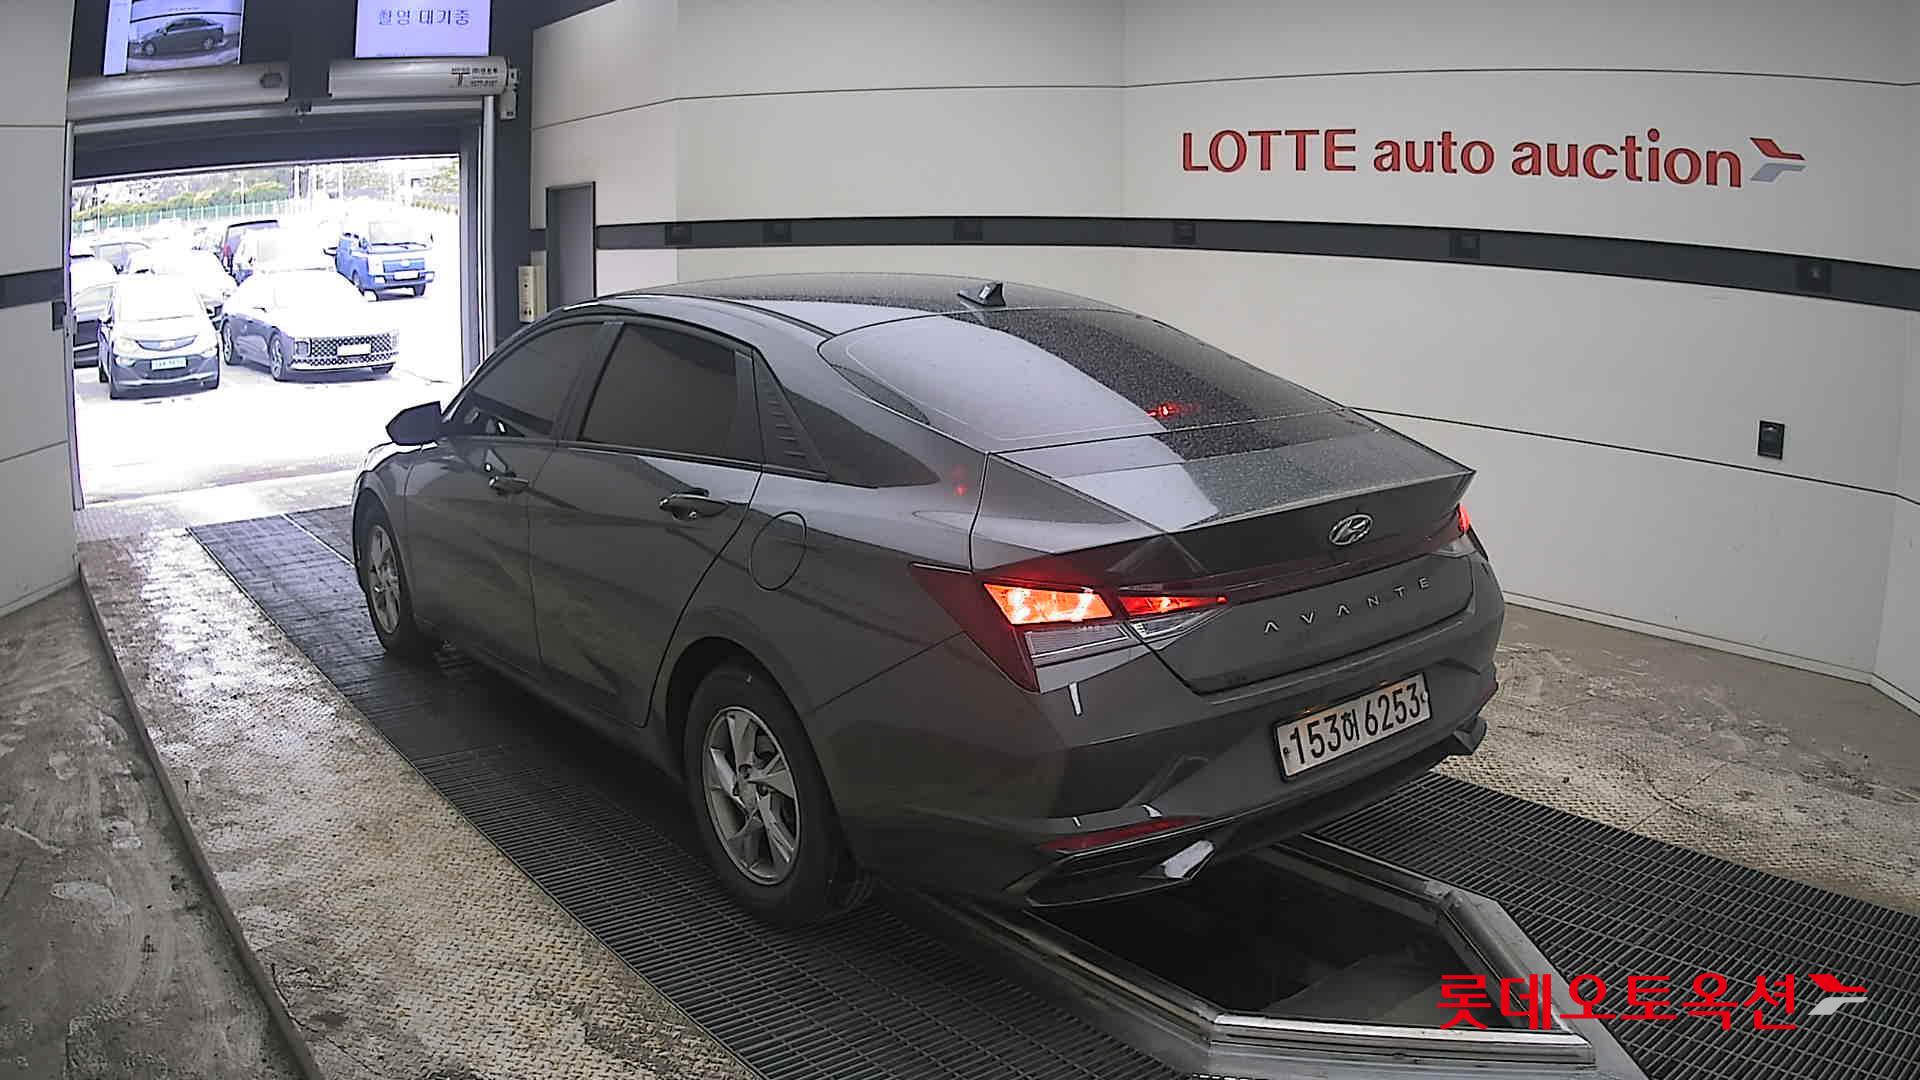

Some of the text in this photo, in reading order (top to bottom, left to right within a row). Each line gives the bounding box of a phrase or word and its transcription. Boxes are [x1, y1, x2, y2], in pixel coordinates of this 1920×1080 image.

[419, 8, 470, 26] 대기중
[1183, 129, 1742, 187] LOTTE auto auction
[1264, 577, 1430, 633] AVANTE
[1364, 682, 1421, 736] 6253
